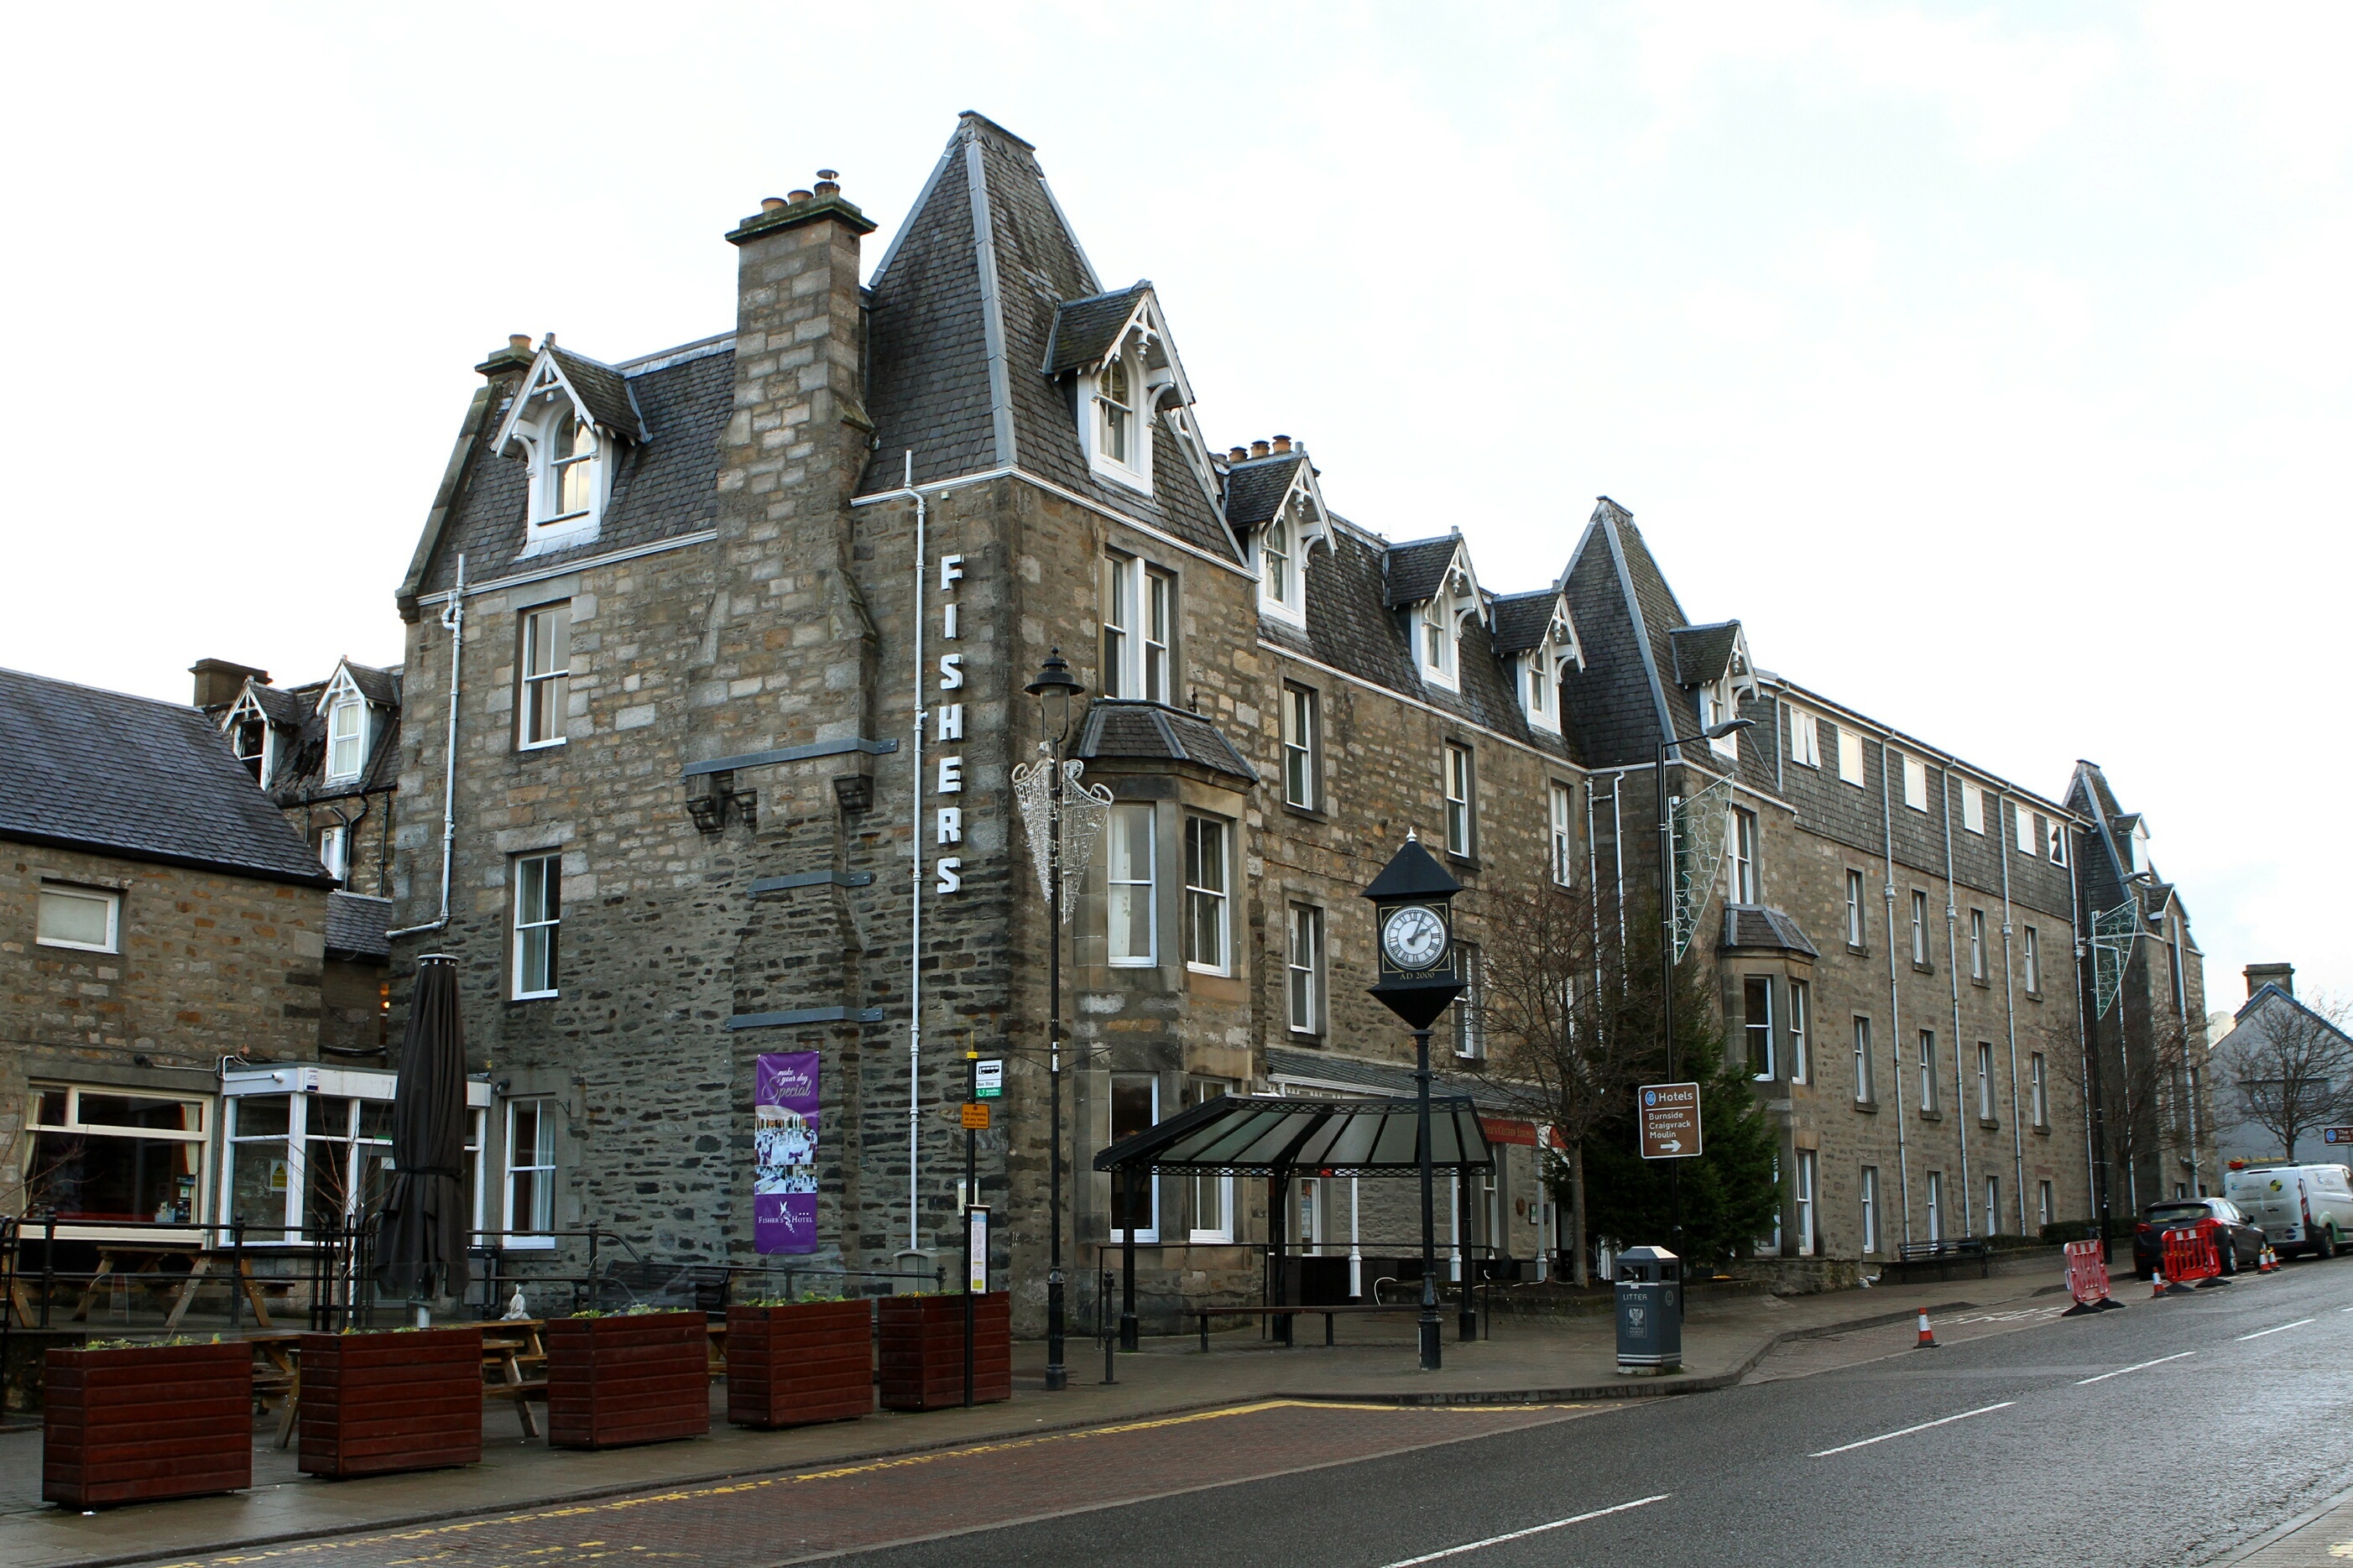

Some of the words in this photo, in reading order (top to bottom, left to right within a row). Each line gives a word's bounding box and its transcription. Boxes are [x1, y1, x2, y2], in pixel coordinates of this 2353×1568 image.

[937, 554, 964, 894] FISHERS
[777, 1066, 794, 1076] make
[779, 1075, 796, 1086] your
[796, 1072, 808, 1086] day
[761, 1076, 812, 1105] Special
[1659, 1091, 1693, 1102] Hotels
[1648, 1112, 1683, 1121] Burnside
[1649, 1120, 1692, 1130] Craigvrack
[759, 1216, 784, 1224] FISHER'S
[791, 1215, 813, 1223] HOTEL
